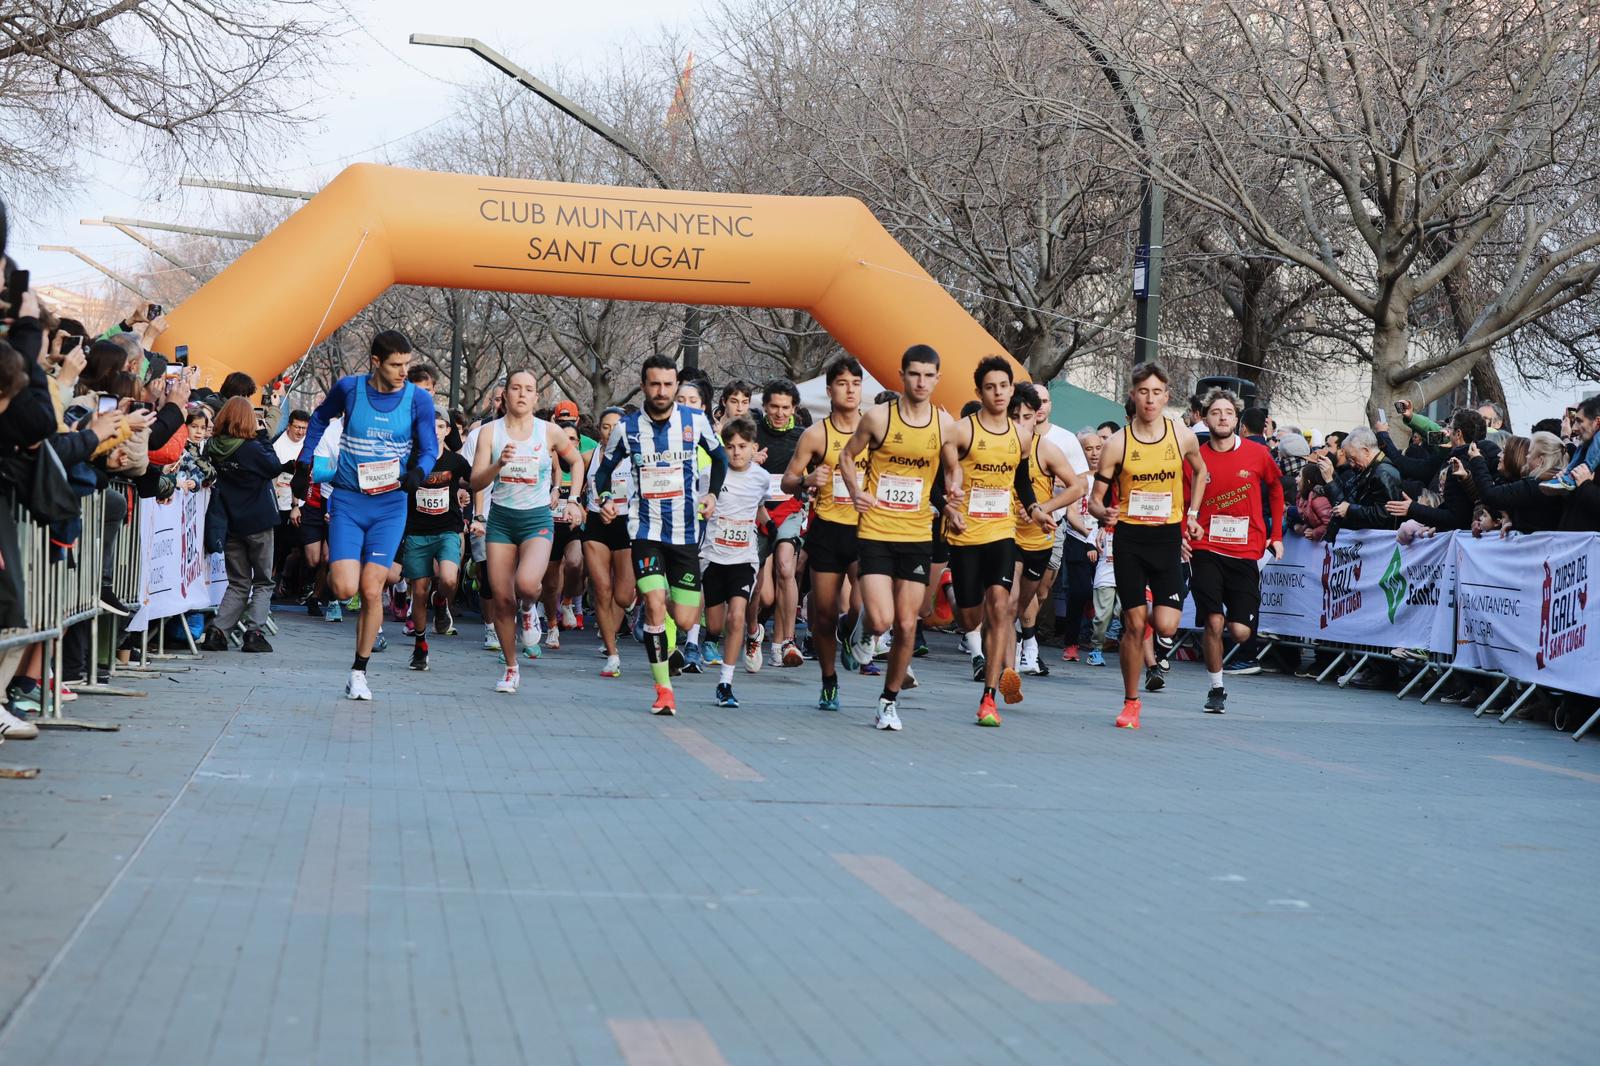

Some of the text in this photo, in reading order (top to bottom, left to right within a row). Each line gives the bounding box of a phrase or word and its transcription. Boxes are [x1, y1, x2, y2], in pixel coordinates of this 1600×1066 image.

[479, 199, 755, 237] CLUB MUNTANYENC
[527, 236, 706, 270] SANT CUGAT
[366, 472, 394, 481] FRANCESC
[422, 498, 444, 508] 1651
[885, 489, 914, 503] 1323
[1217, 490, 1236, 502] anys
[1237, 483, 1252, 493] amb
[723, 528, 747, 541] 1353
[1330, 566, 1353, 601] GALL
[1553, 554, 1588, 594] CURSA DEL
[1262, 592, 1284, 607] CUGAT
[1331, 591, 1362, 621] SANT CUGAT
[1552, 589, 1578, 635] GALL
[1549, 623, 1587, 661] SANT CUGAT
